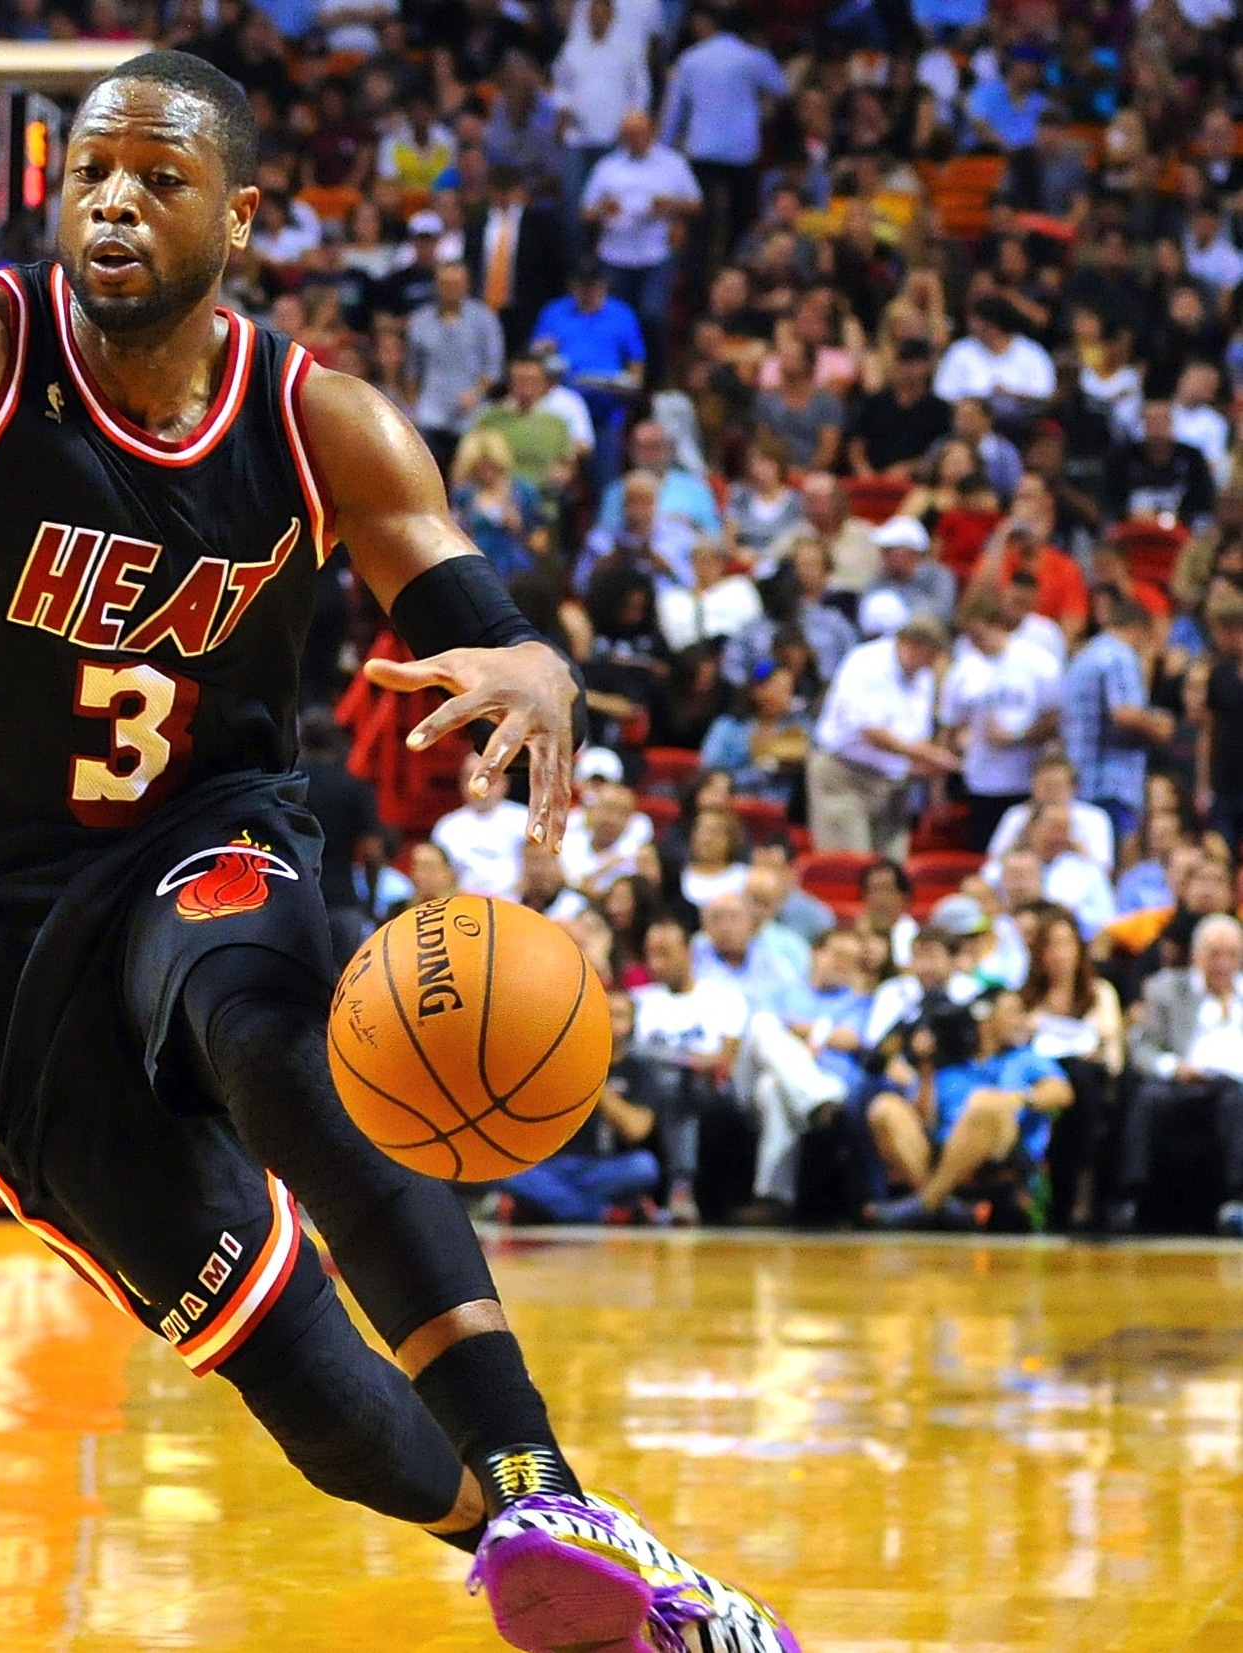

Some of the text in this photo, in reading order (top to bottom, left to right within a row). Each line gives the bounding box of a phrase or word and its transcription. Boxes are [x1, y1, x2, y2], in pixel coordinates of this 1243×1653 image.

[7, 516, 301, 657] HEAT
[69, 661, 188, 815] 3
[160, 1231, 243, 1344] MIAMI
